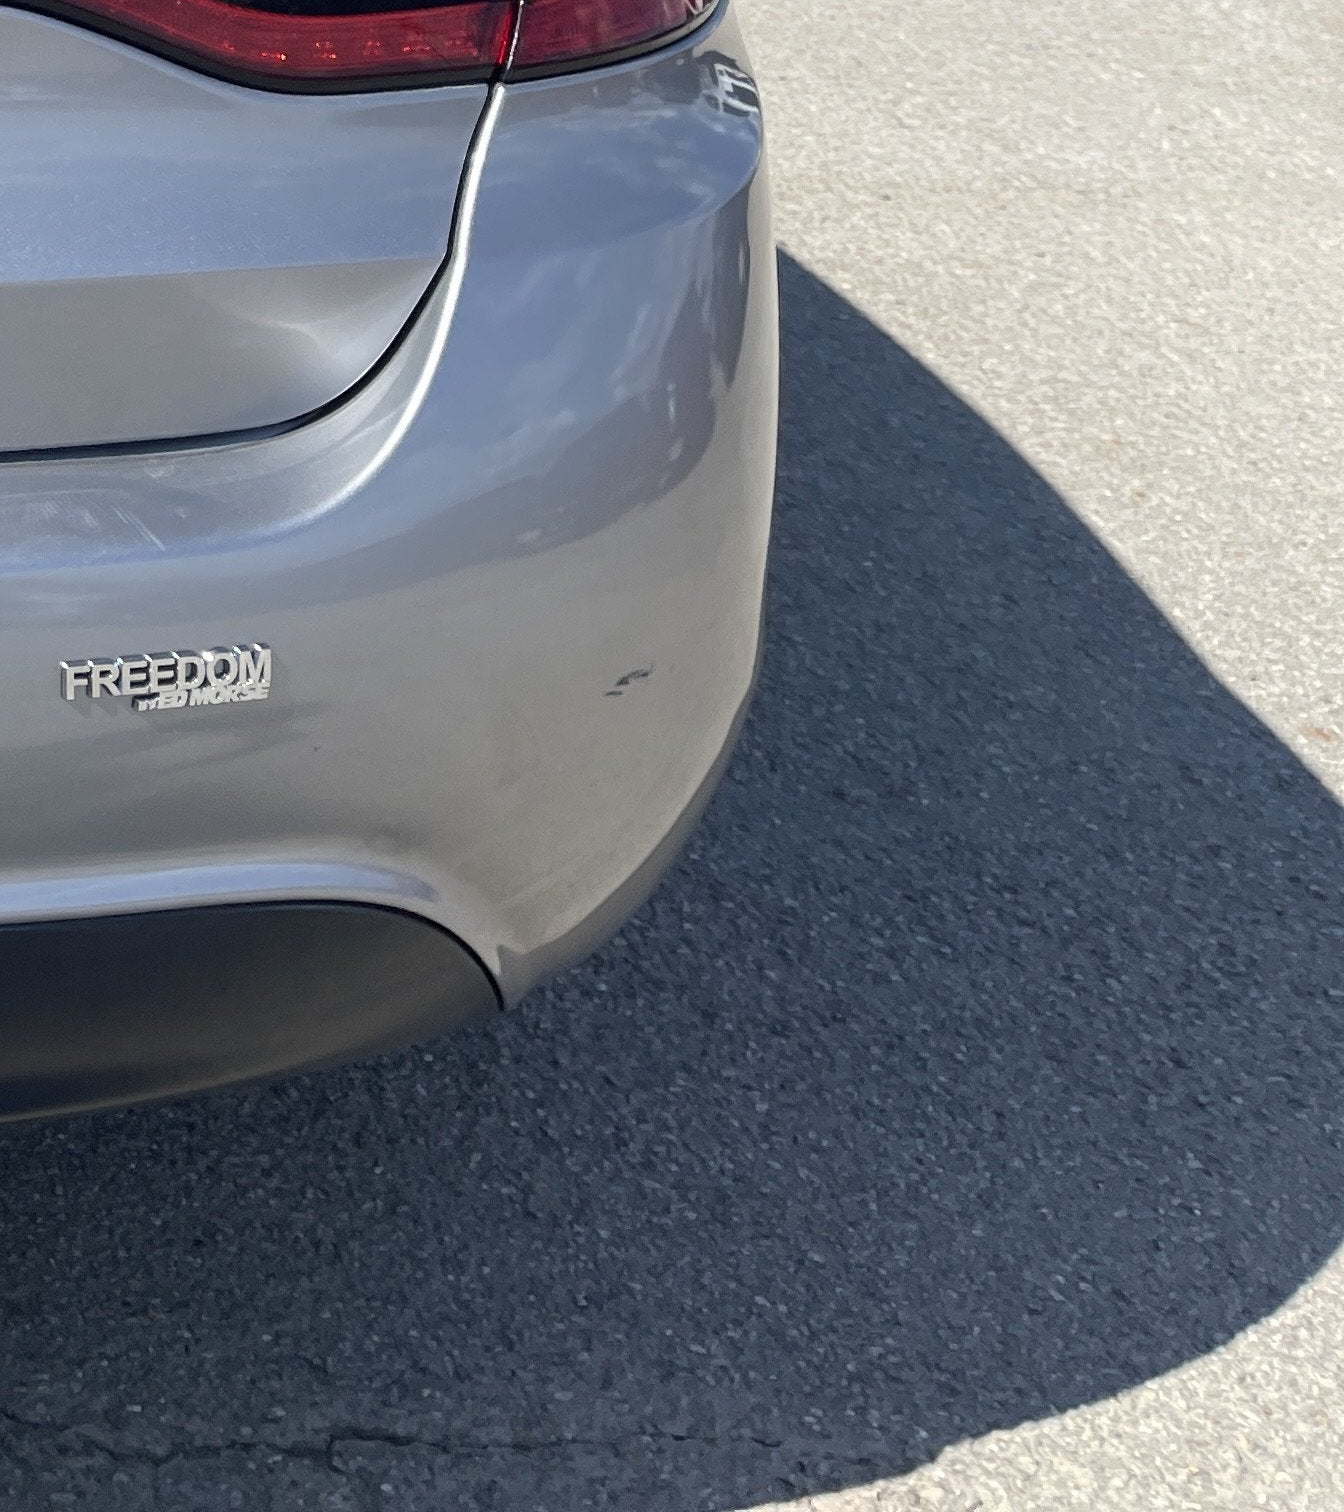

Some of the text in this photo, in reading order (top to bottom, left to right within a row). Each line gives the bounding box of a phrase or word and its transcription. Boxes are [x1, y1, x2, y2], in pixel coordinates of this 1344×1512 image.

[61, 642, 272, 701] FREEDOM
[158, 689, 187, 709] ED
[189, 686, 270, 707] MORSE
